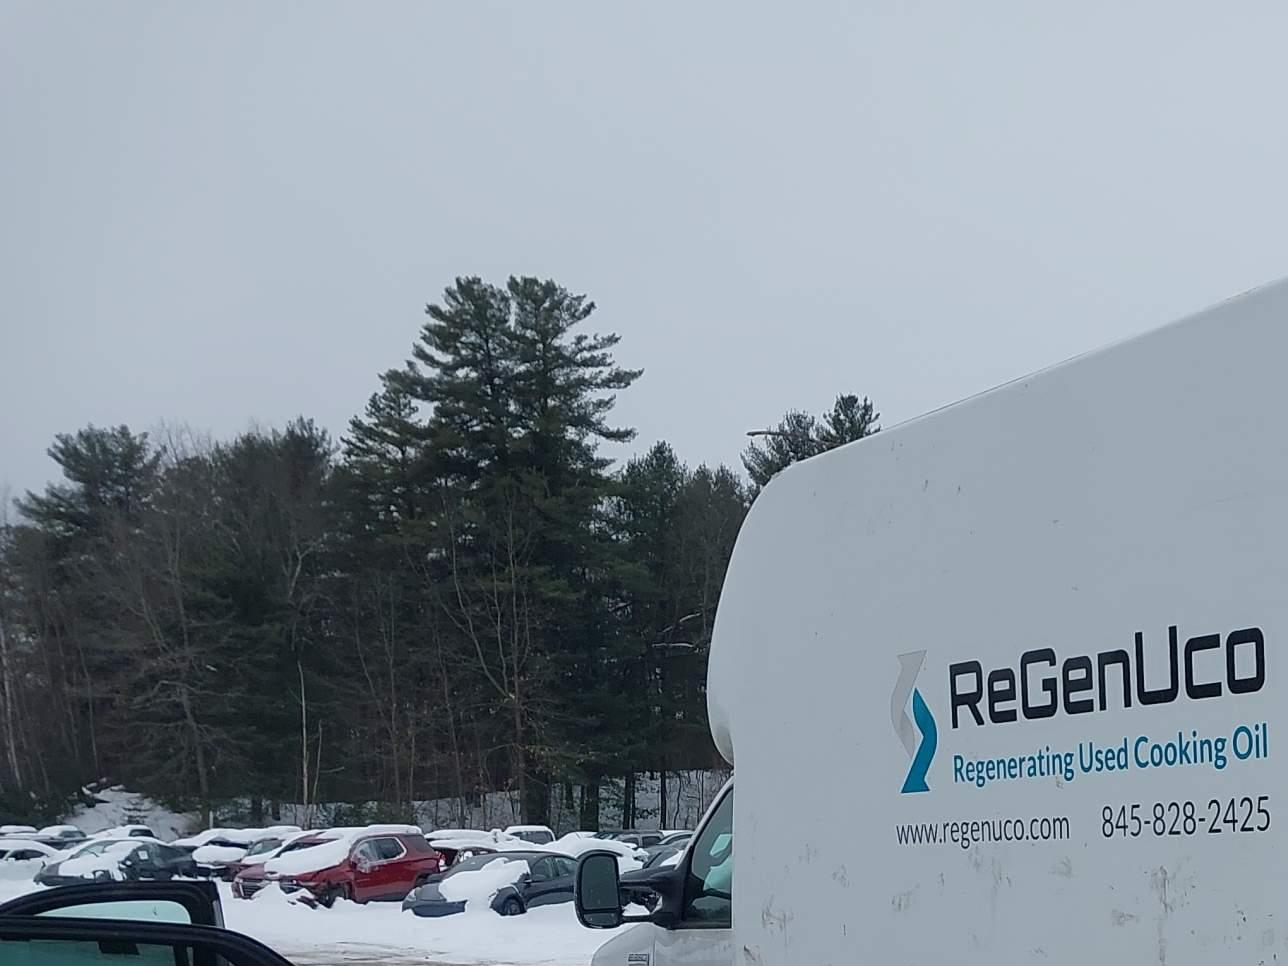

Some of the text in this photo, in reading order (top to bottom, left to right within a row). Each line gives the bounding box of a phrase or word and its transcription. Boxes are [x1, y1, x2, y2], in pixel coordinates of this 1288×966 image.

[949, 626, 1265, 729] ReGenUco
[954, 723, 1269, 788] Regenerating Used Cooking Oil
[896, 796, 1271, 849] www.regenuco.com 845-828-2425
